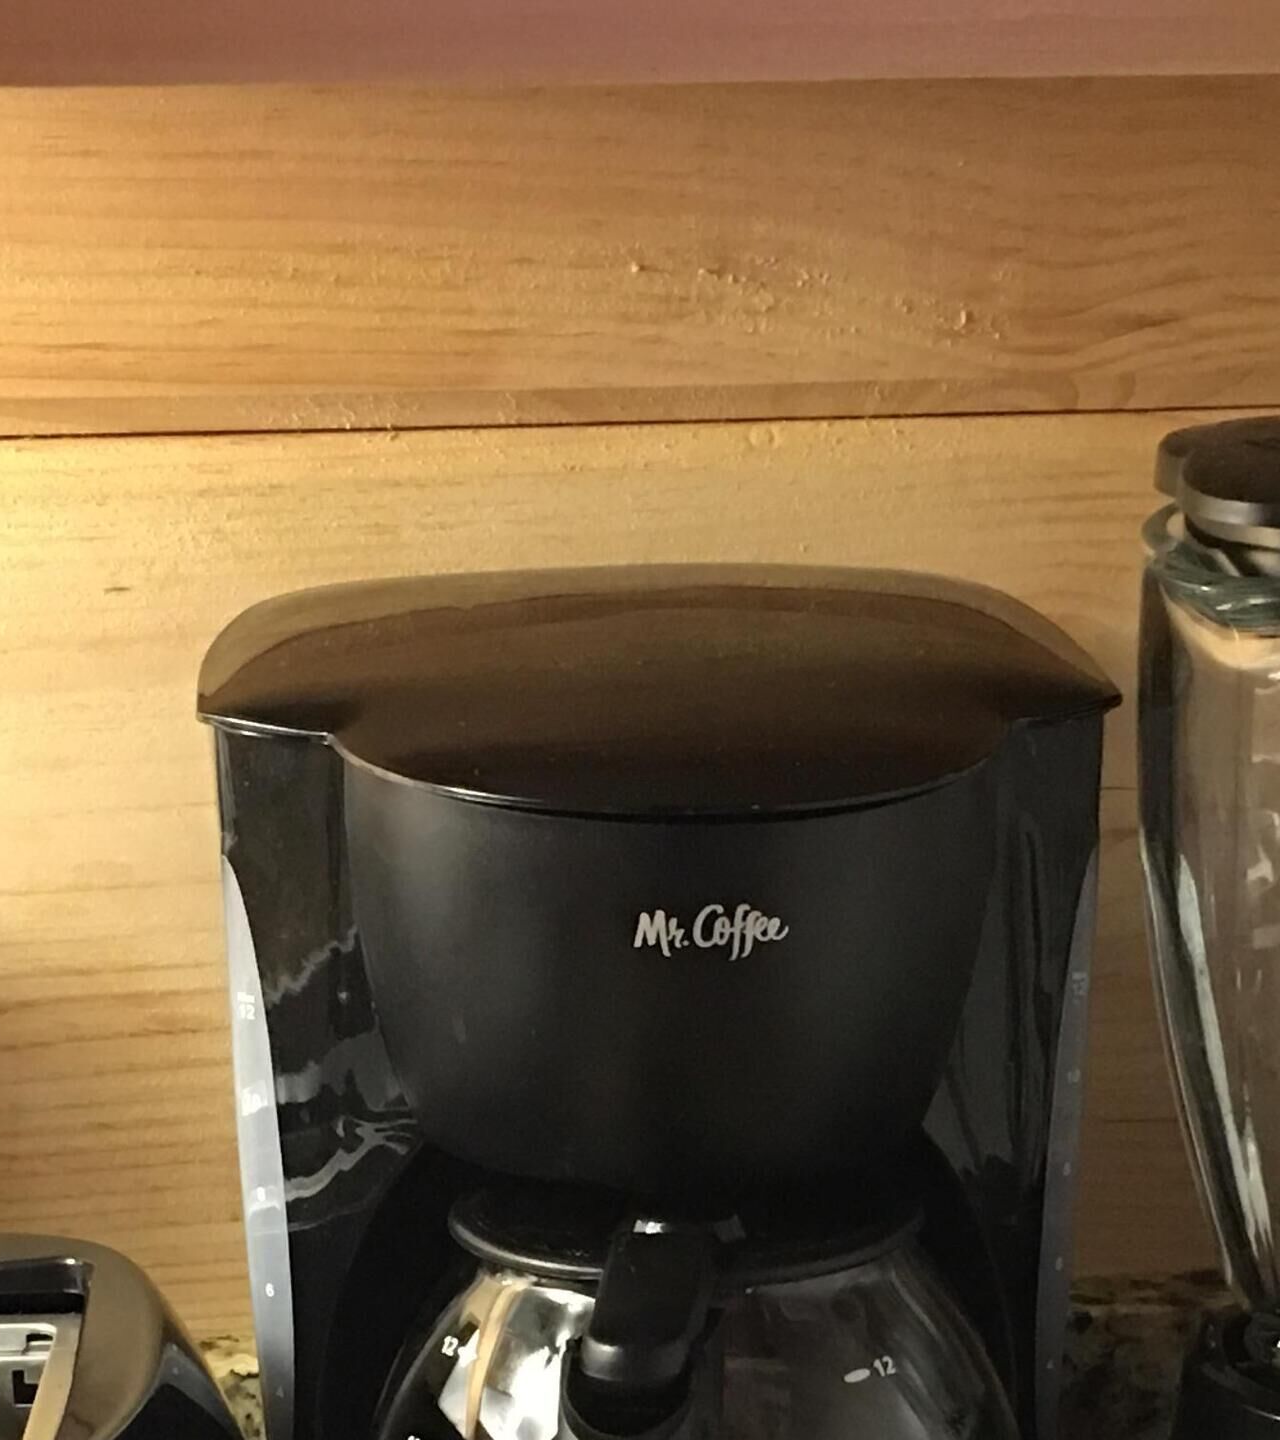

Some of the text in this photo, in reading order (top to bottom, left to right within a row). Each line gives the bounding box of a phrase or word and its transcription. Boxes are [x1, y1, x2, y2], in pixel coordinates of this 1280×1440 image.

[633, 903, 790, 961] Mr. Coffee
[265, 1282, 275, 1298] 6
[441, 1335, 459, 1357] 12
[873, 1355, 896, 1377] 12
